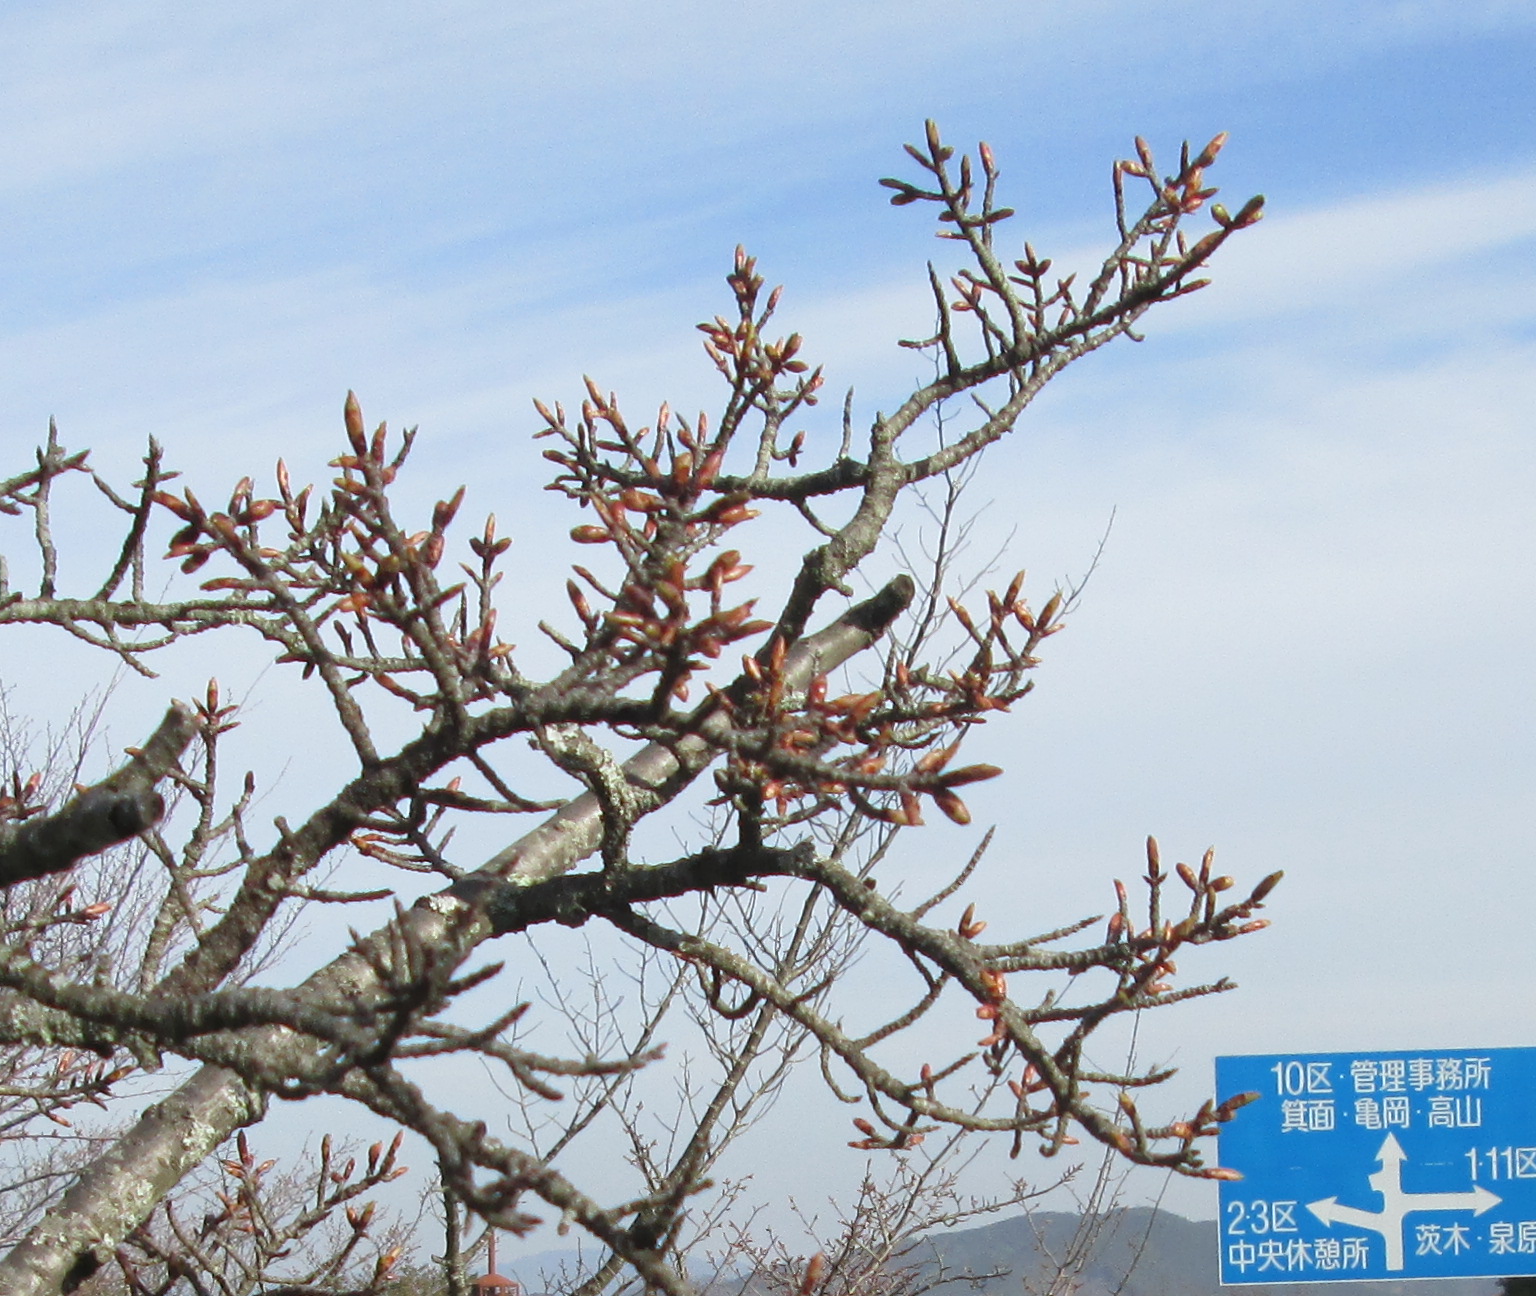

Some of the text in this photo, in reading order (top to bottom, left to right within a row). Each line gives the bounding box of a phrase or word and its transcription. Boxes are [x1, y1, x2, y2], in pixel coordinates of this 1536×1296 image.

[1228, 1237, 1370, 1274] 中央休憩所
